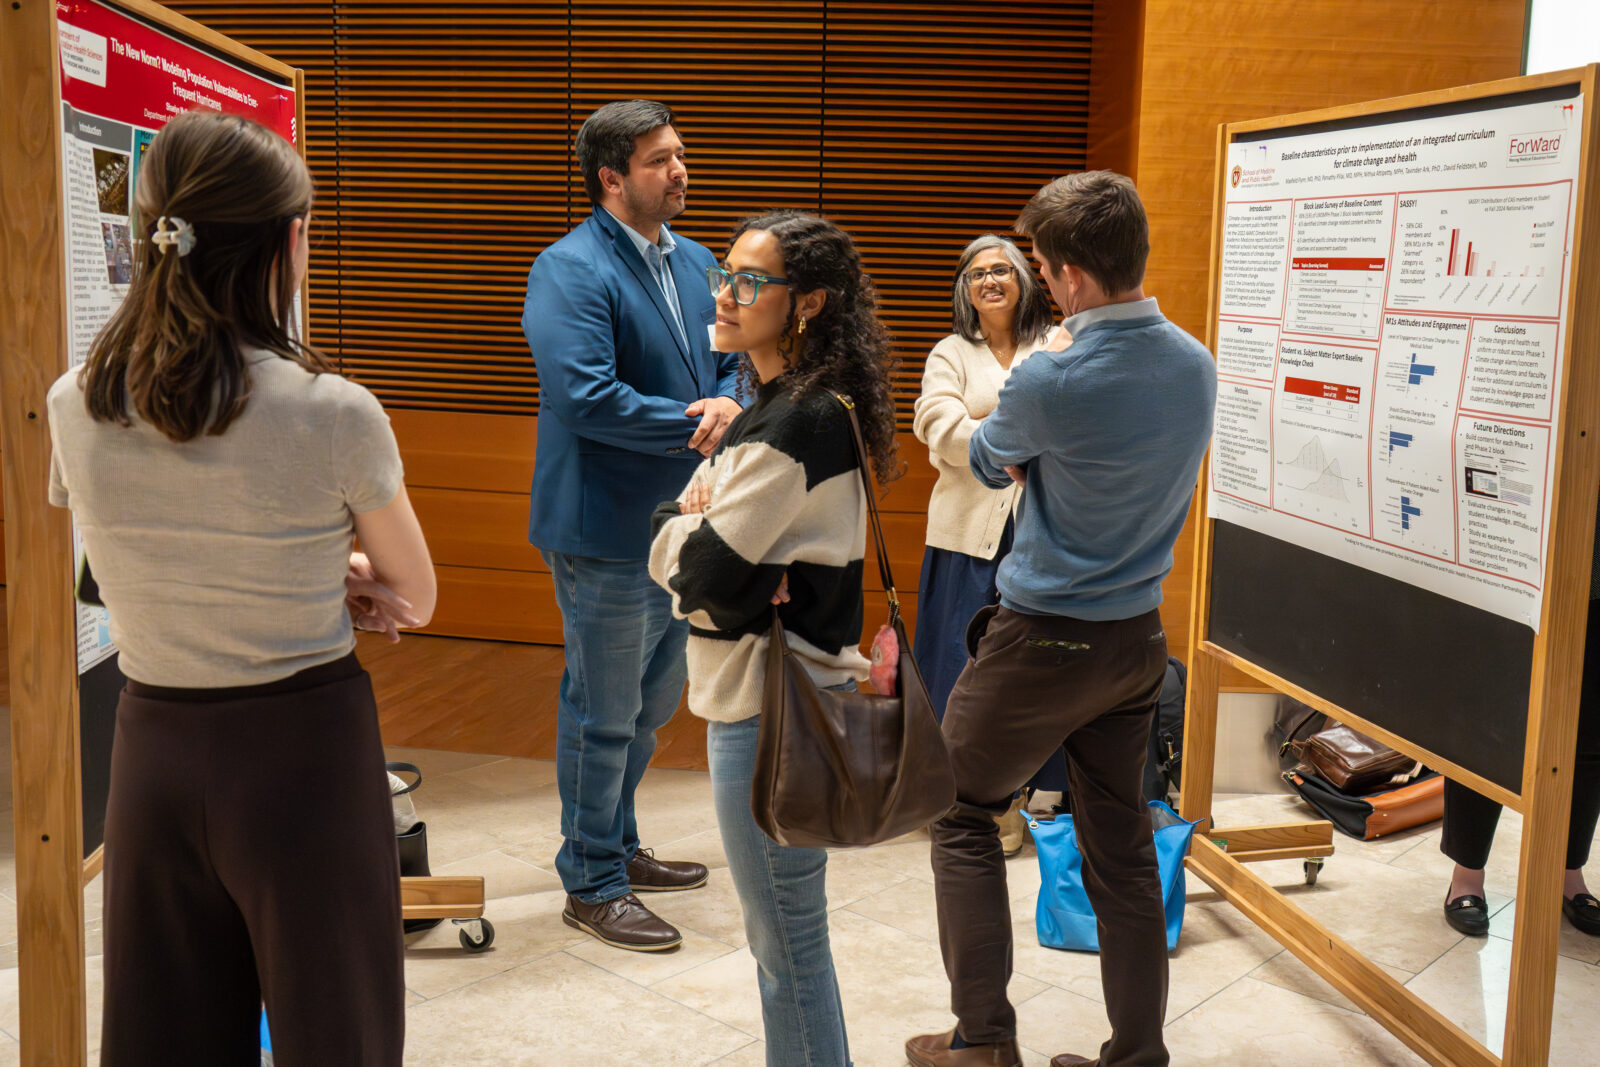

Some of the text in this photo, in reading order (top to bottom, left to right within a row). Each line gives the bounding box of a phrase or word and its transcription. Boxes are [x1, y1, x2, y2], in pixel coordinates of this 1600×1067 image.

[110, 36, 124, 56] The
[126, 42, 140, 62] New
[141, 48, 160, 70] Norm?
[162, 57, 187, 82] Modeling
[187, 68, 214, 91] Population
[212, 79, 243, 103] Vulnerabilities
[172, 82, 196, 102] Frequent
[196, 90, 222, 112] Hurricanes
[79, 122, 102, 136] Introduction
[1282, 152, 1300, 161] Baseline
[1302, 148, 1336, 158] characteristics
[1337, 146, 1351, 157] prior
[1359, 140, 1404, 152] implementation
[1405, 137, 1412, 147] of
[1413, 138, 1421, 146] an
[1423, 132, 1456, 146] integrated
[1458, 129, 1495, 141] curriculum
[1510, 134, 1561, 154] ForWard
[1343, 157, 1362, 167] climate
[1363, 156, 1383, 167] change
[1385, 154, 1396, 163] and
[1398, 153, 1417, 163] health
[1444, 163, 1455, 171] David
[1479, 161, 1487, 169] MD
[1400, 200, 1417, 208] SASSY!
[1238, 326, 1252, 334] Purpose
[1398, 318, 1420, 327] Attitudes
[1433, 322, 1467, 331] Engagement
[1494, 325, 1527, 335] Conclusions
[1479, 336, 1493, 344] Climate
[1494, 337, 1506, 346] change
[1281, 346, 1297, 355] Student
[1303, 349, 1317, 358] Subject
[1318, 350, 1331, 358] Matter
[1332, 352, 1345, 361] Expert
[1345, 353, 1363, 362] Baseline
[1280, 357, 1314, 368] Knowledge Check
[1476, 356, 1539, 367] Climate change alarm/concern
[1485, 367, 1498, 376] among
[1499, 368, 1517, 376] students
[1528, 371, 1546, 380] faculty
[1493, 377, 1514, 386] additional
[1515, 380, 1542, 389] curriculum
[1235, 386, 1248, 395] Methods
[1471, 385, 1546, 400] supported by knowledge gaps and
[1485, 396, 1535, 410] attitudes/engagement
[1473, 422, 1525, 438] Future Directions
[1477, 435, 1494, 444] content
[1503, 439, 1513, 447] each
[1514, 441, 1528, 450] Phase
[1475, 445, 1487, 454] Phase
[1493, 447, 1505, 455] block
[1468, 501, 1485, 510] Evaluate
[1487, 505, 1505, 514] changes
[1468, 511, 1484, 519] student
[1469, 520, 1488, 529] practices
[1469, 528, 1481, 538] Study
[1488, 534, 1507, 544] example
[1487, 562, 1508, 572] problems
